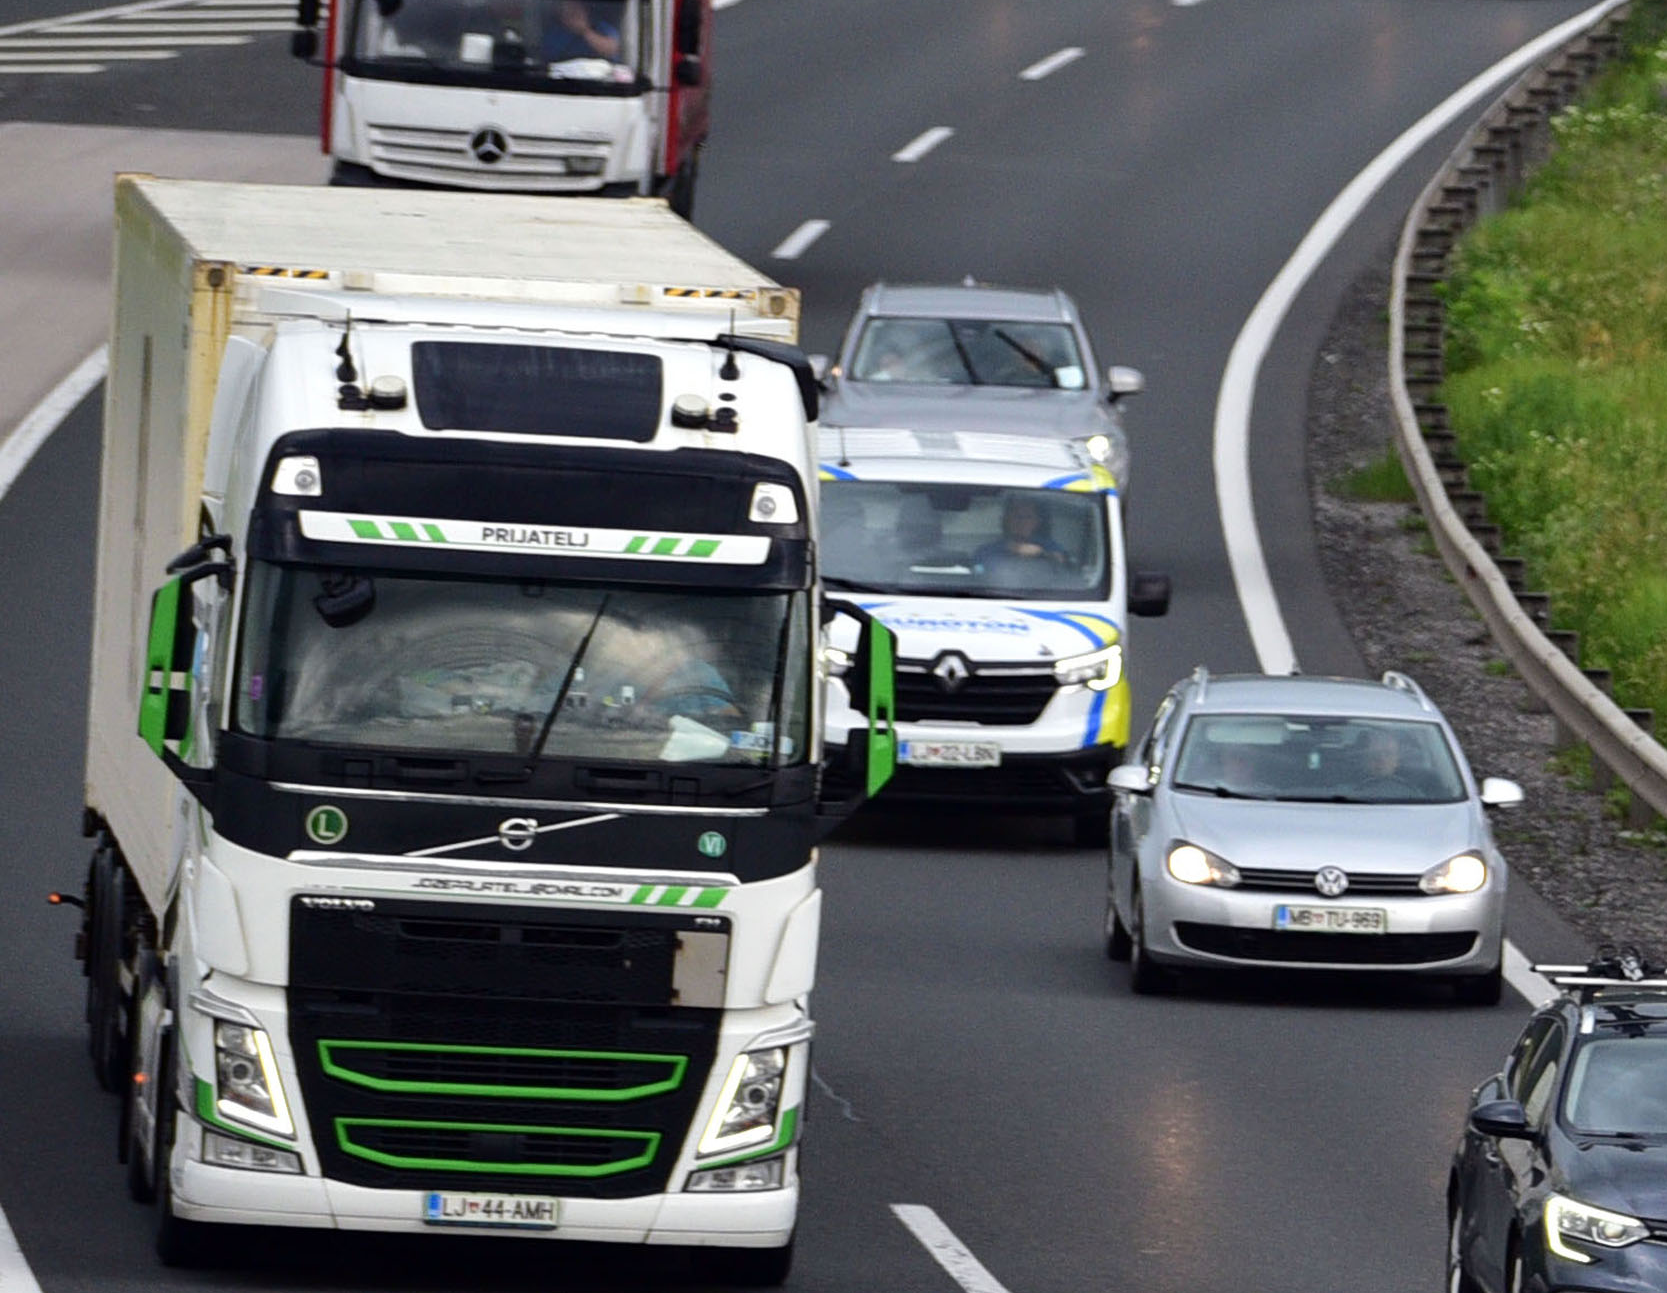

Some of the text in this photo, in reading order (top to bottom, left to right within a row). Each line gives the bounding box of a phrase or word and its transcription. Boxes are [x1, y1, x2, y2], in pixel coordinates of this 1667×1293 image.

[481, 526, 589, 547] PRIJATELJ
[442, 1197, 554, 1221] LJ 44-AMH
